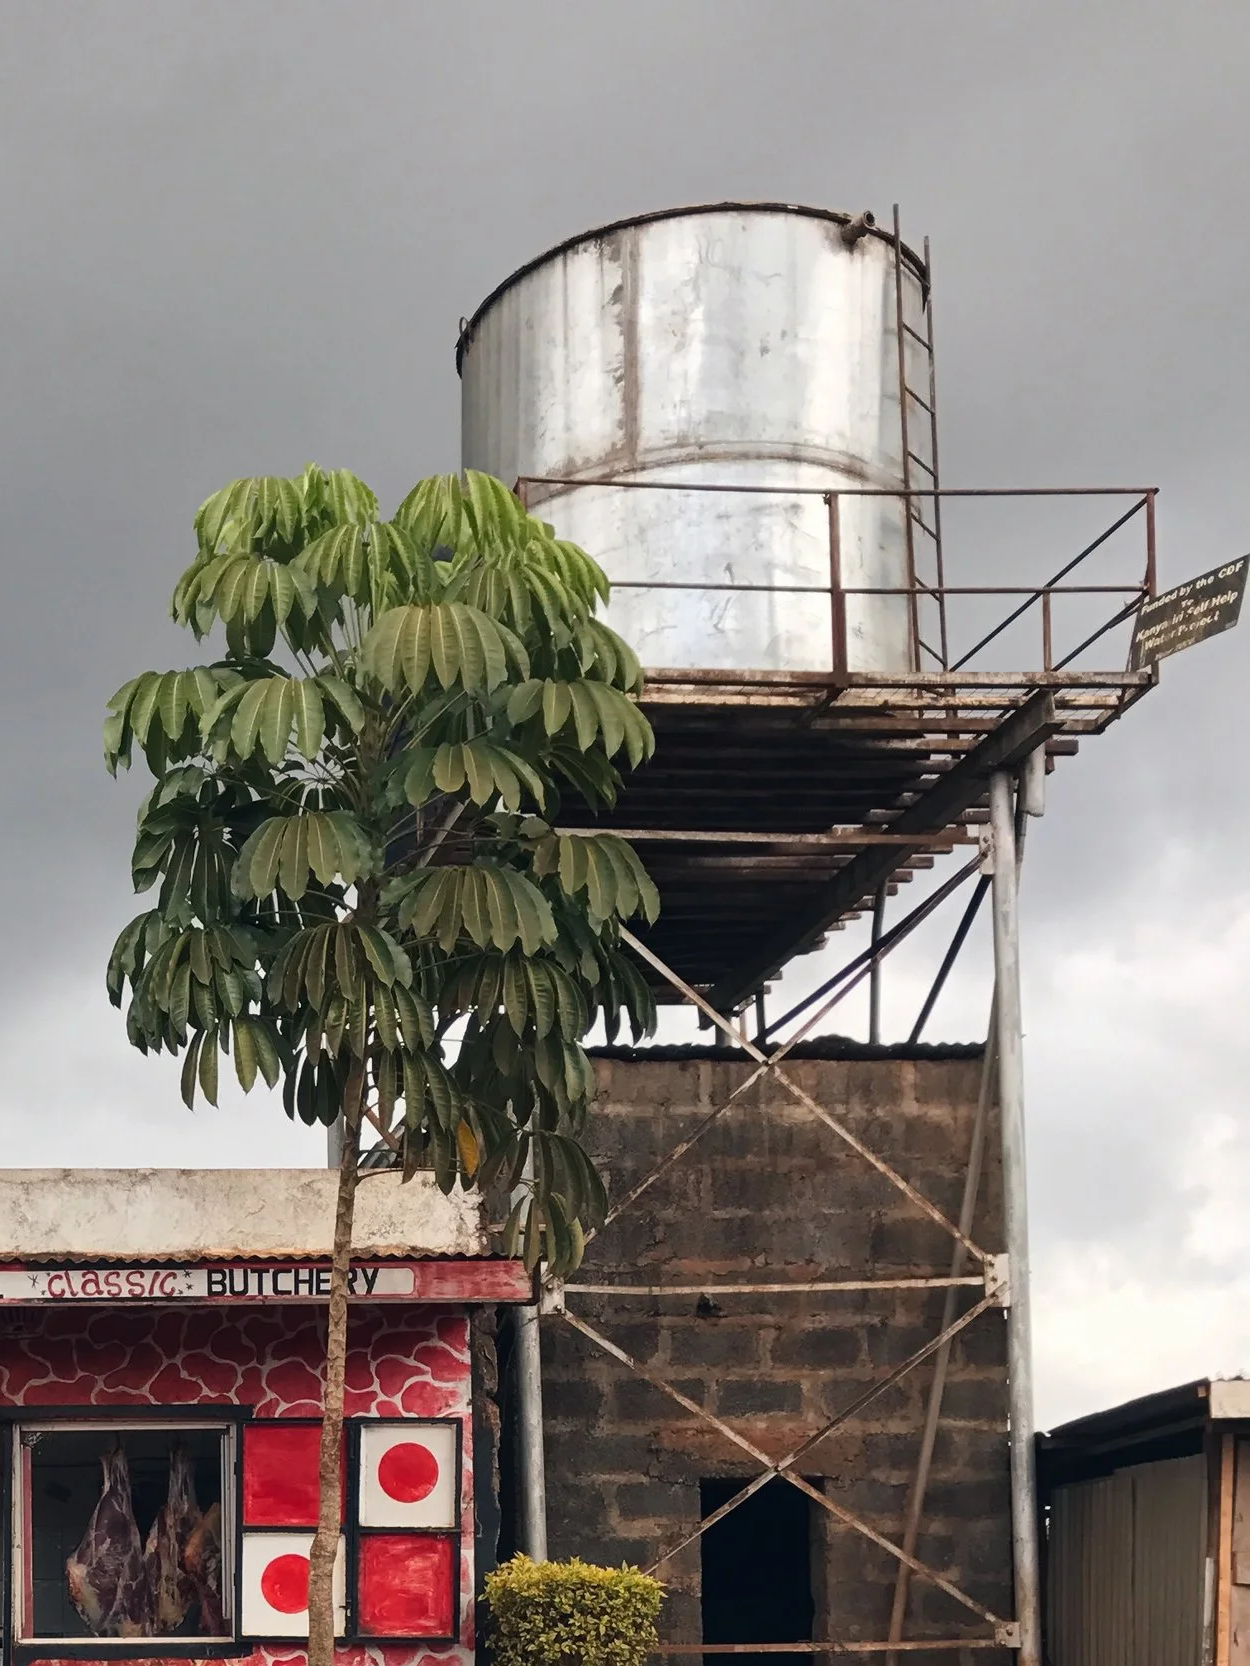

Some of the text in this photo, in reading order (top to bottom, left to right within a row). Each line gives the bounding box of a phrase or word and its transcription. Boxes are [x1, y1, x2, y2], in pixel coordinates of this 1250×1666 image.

[1141, 560, 1244, 616] Funded by the CDF
[1135, 610, 1184, 643] Kanyairi
[1211, 590, 1239, 608] Help
[1145, 629, 1177, 650] Watr
[207, 1268, 380, 1297] BUTCHERY
